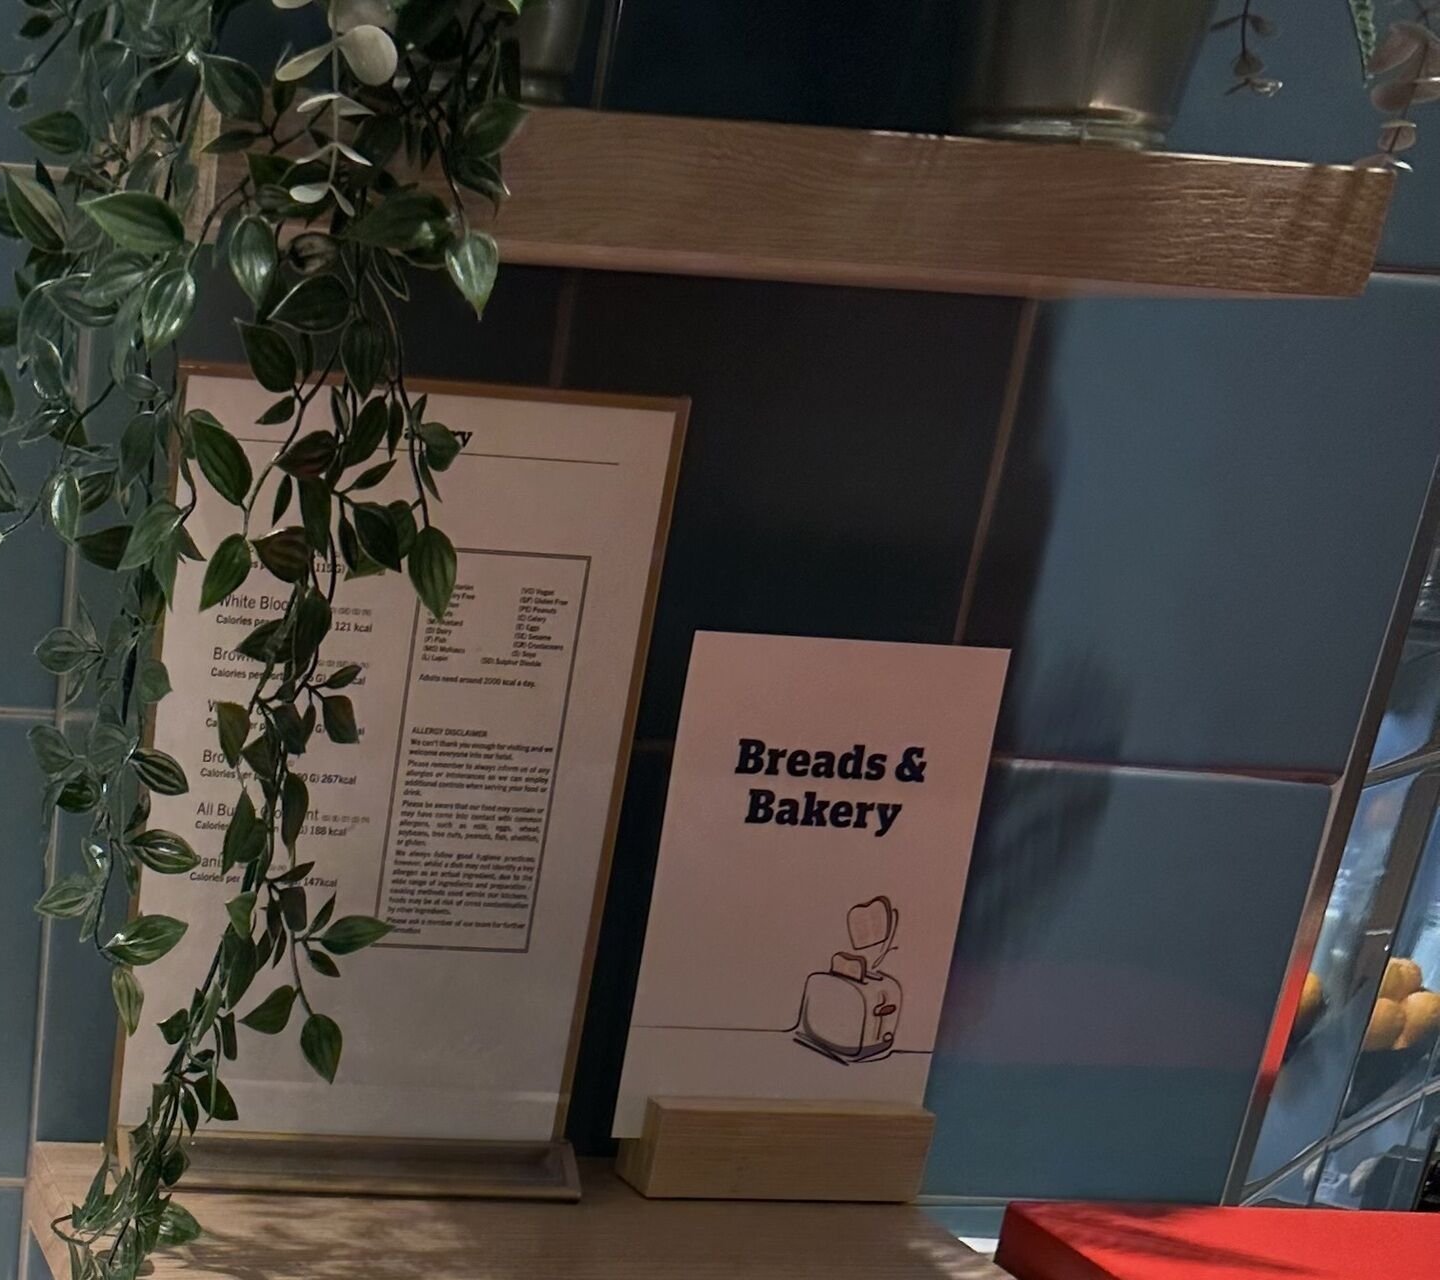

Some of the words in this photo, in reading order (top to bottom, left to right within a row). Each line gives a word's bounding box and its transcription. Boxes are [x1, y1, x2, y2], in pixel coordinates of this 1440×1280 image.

[221, 594, 256, 609] White
[259, 596, 288, 611] Bloo
[216, 615, 252, 626] Calories
[335, 621, 351, 632] 121
[353, 622, 373, 633] kcal
[211, 667, 247, 679] Calories
[412, 726, 443, 736] ALLERGY
[444, 728, 488, 738] DISCLAIMER
[471, 743, 495, 751] enough
[507, 744, 529, 753] visiting
[439, 751, 468, 759] everyone
[735, 738, 888, 780] Breads
[895, 746, 928, 784] &
[201, 767, 237, 779] Calories
[196, 802, 214, 816] All
[744, 788, 903, 838] Bakery
[195, 820, 229, 831] Calorie
[328, 826, 348, 836] kcal
[226, 875, 241, 884] per
